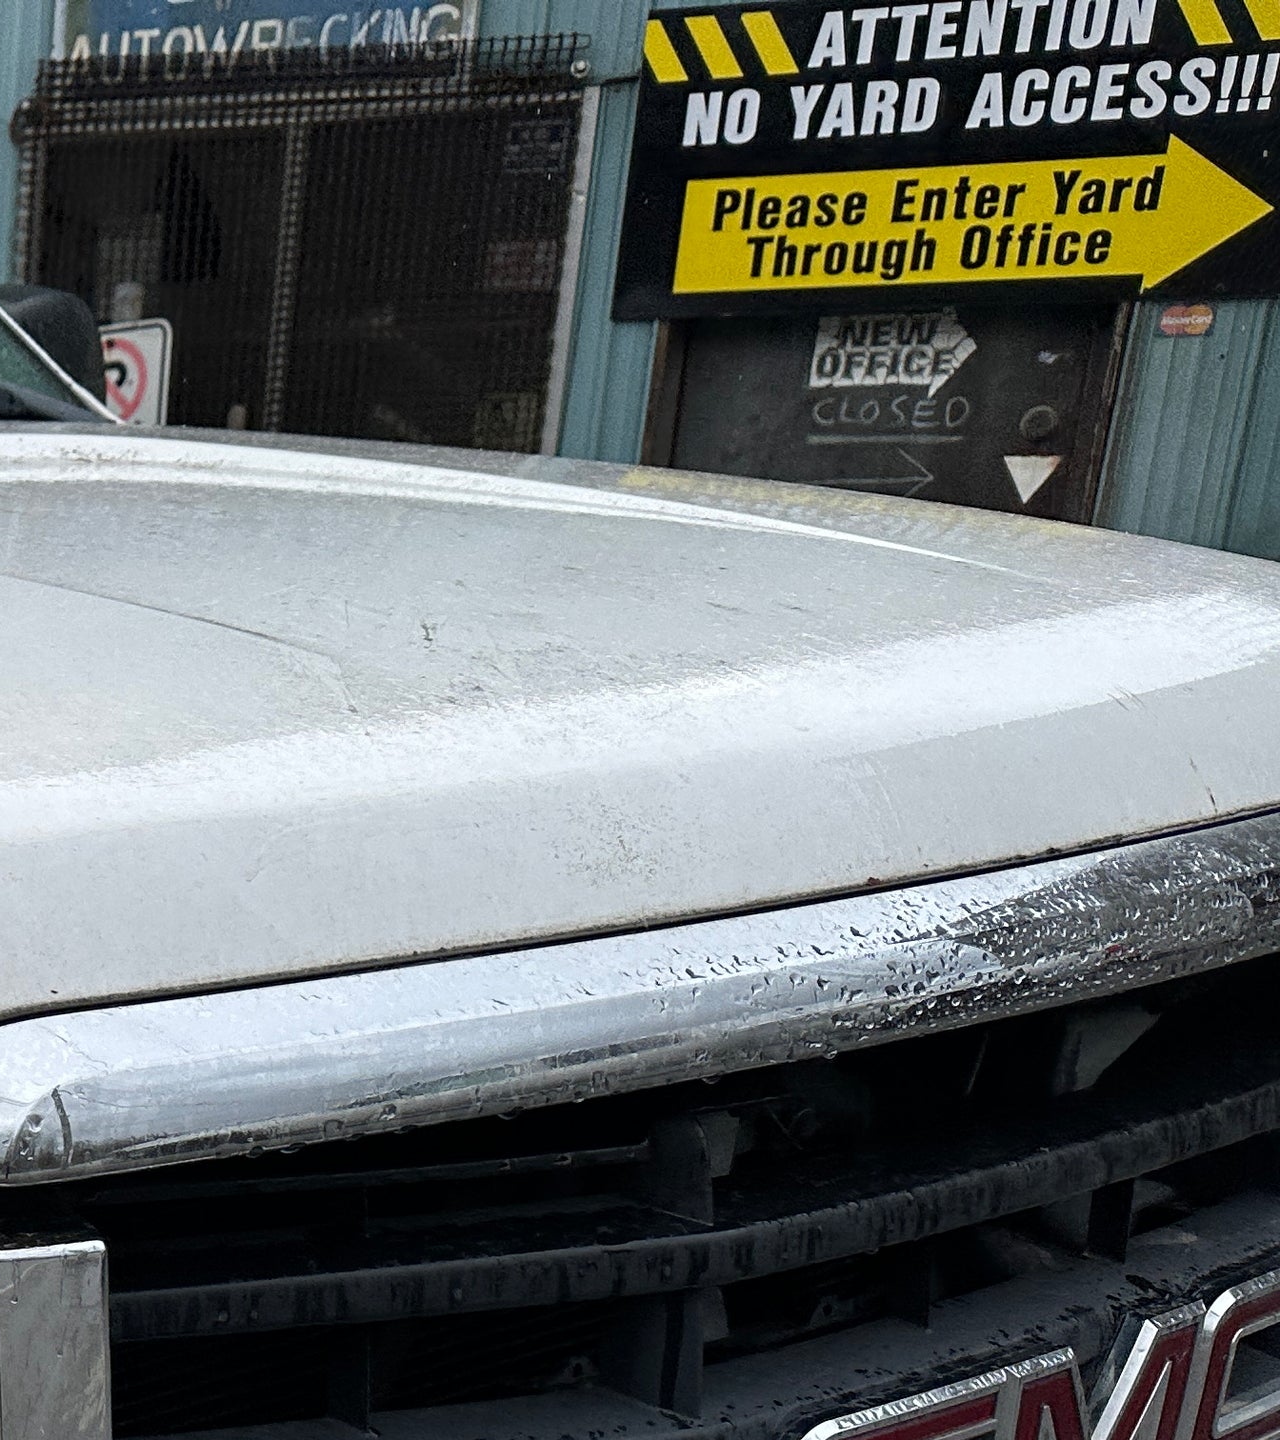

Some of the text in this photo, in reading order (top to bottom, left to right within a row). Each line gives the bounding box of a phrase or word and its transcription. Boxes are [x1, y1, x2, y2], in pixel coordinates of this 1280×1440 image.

[808, 0, 1156, 68] ATTENTION
[682, 53, 1280, 147] NO YARD ACCESS!!!
[712, 166, 1166, 231] Please Enter Yard
[746, 222, 1112, 281] Through Office
[839, 317, 940, 348] NEW
[815, 347, 954, 379] OFFICE
[812, 395, 970, 429] CLOSED
